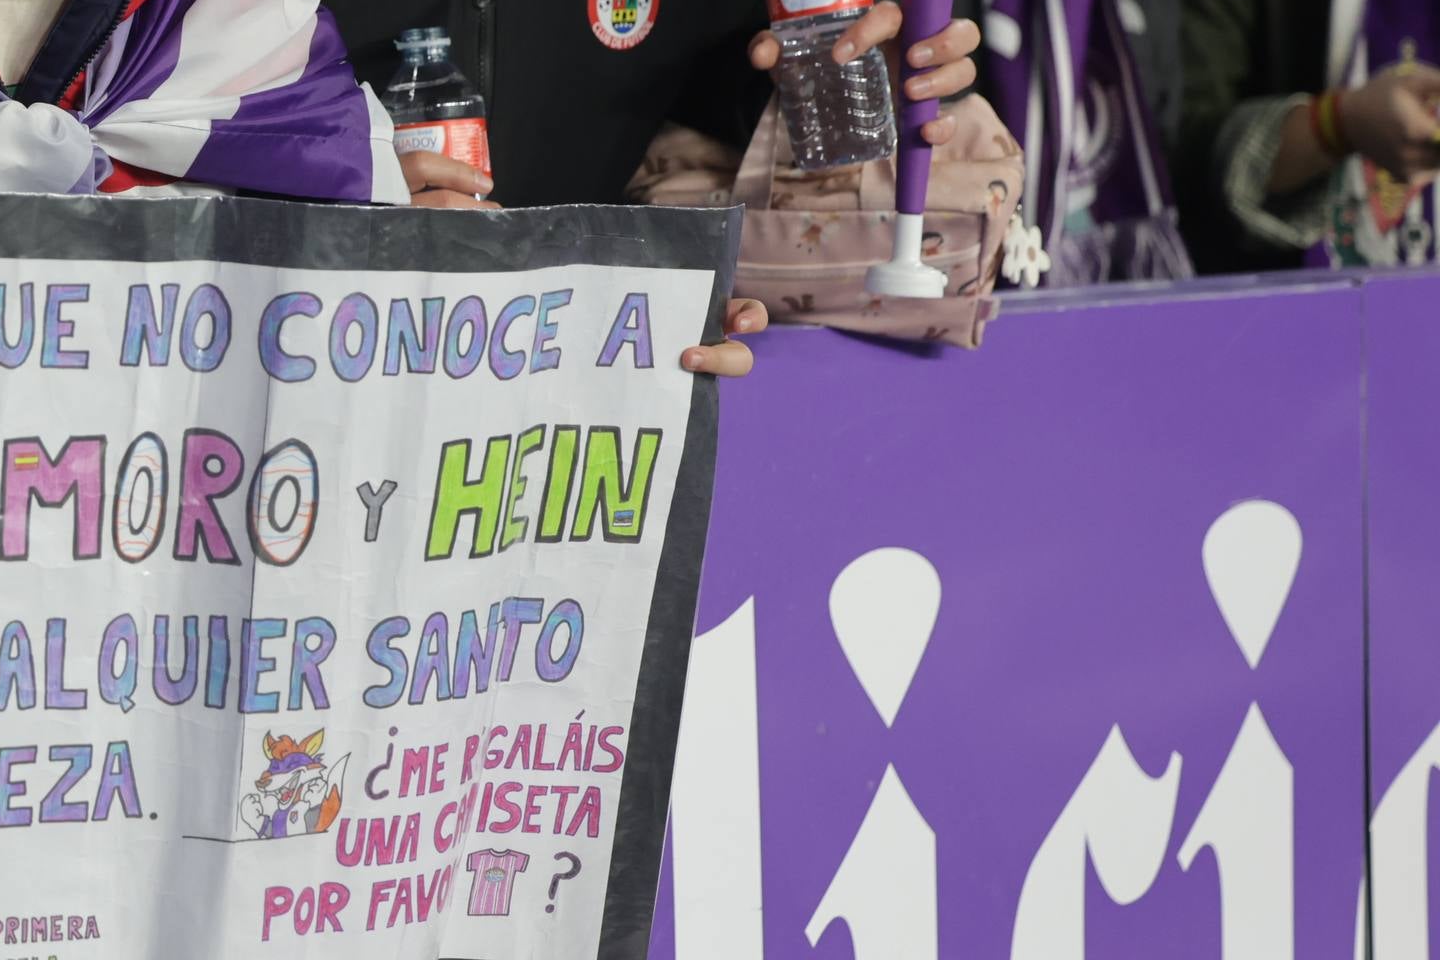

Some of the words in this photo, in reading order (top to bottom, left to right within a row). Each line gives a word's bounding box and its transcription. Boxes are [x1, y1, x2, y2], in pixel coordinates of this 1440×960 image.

[119, 282, 232, 373] NO
[259, 288, 574, 383] CONOCE
[595, 292, 655, 369] A
[355, 479, 398, 542] Y
[423, 423, 664, 562] HEIN
[362, 596, 585, 709] SANTO
[363, 726, 449, 801] ¿ME
[460, 709, 625, 785] RGALÁIS
[335, 812, 421, 867] UNA
[261, 881, 351, 942] POR
[365, 860, 458, 931] FAVO
